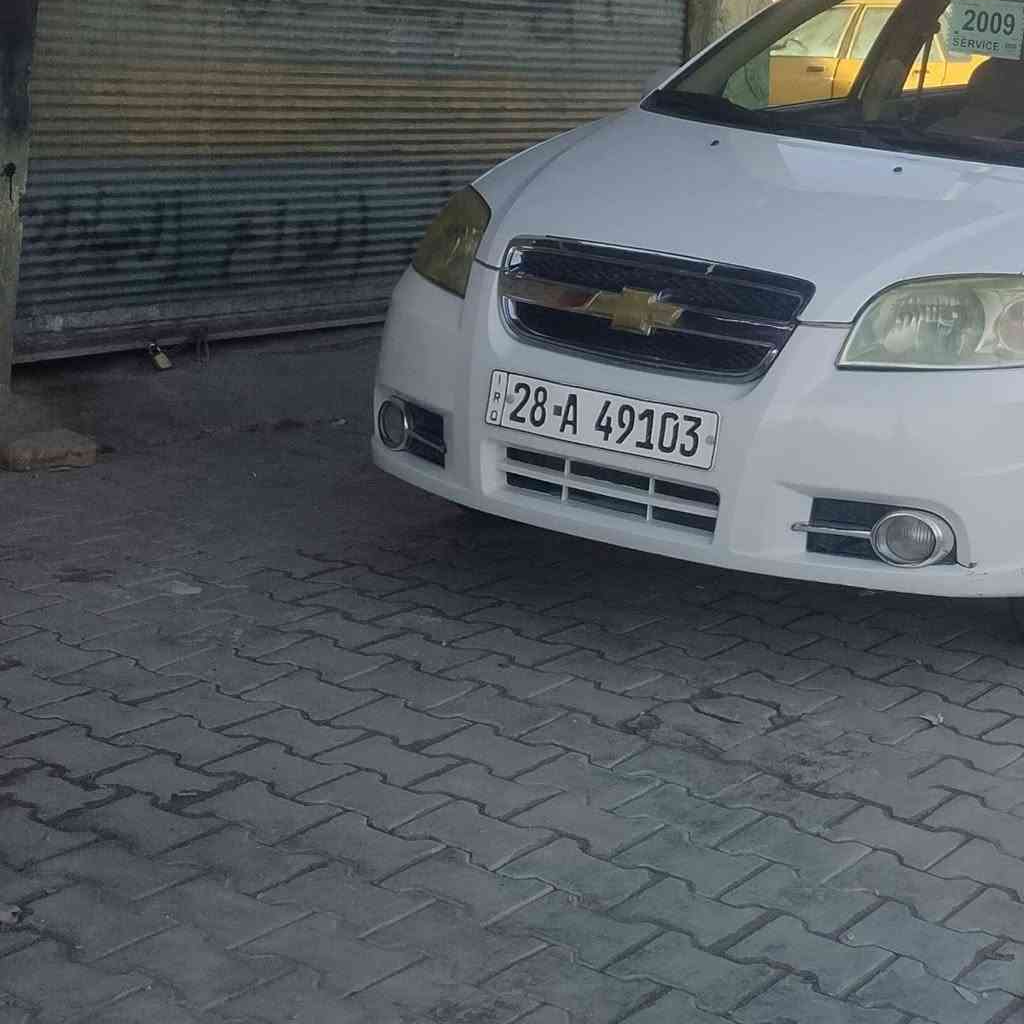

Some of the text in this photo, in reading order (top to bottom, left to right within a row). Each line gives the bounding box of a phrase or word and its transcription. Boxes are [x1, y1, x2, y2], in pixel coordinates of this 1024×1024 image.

[961, 9, 1016, 36] 2009
[952, 37, 1000, 51] SERVICE
[594, 400, 703, 458] 49103
